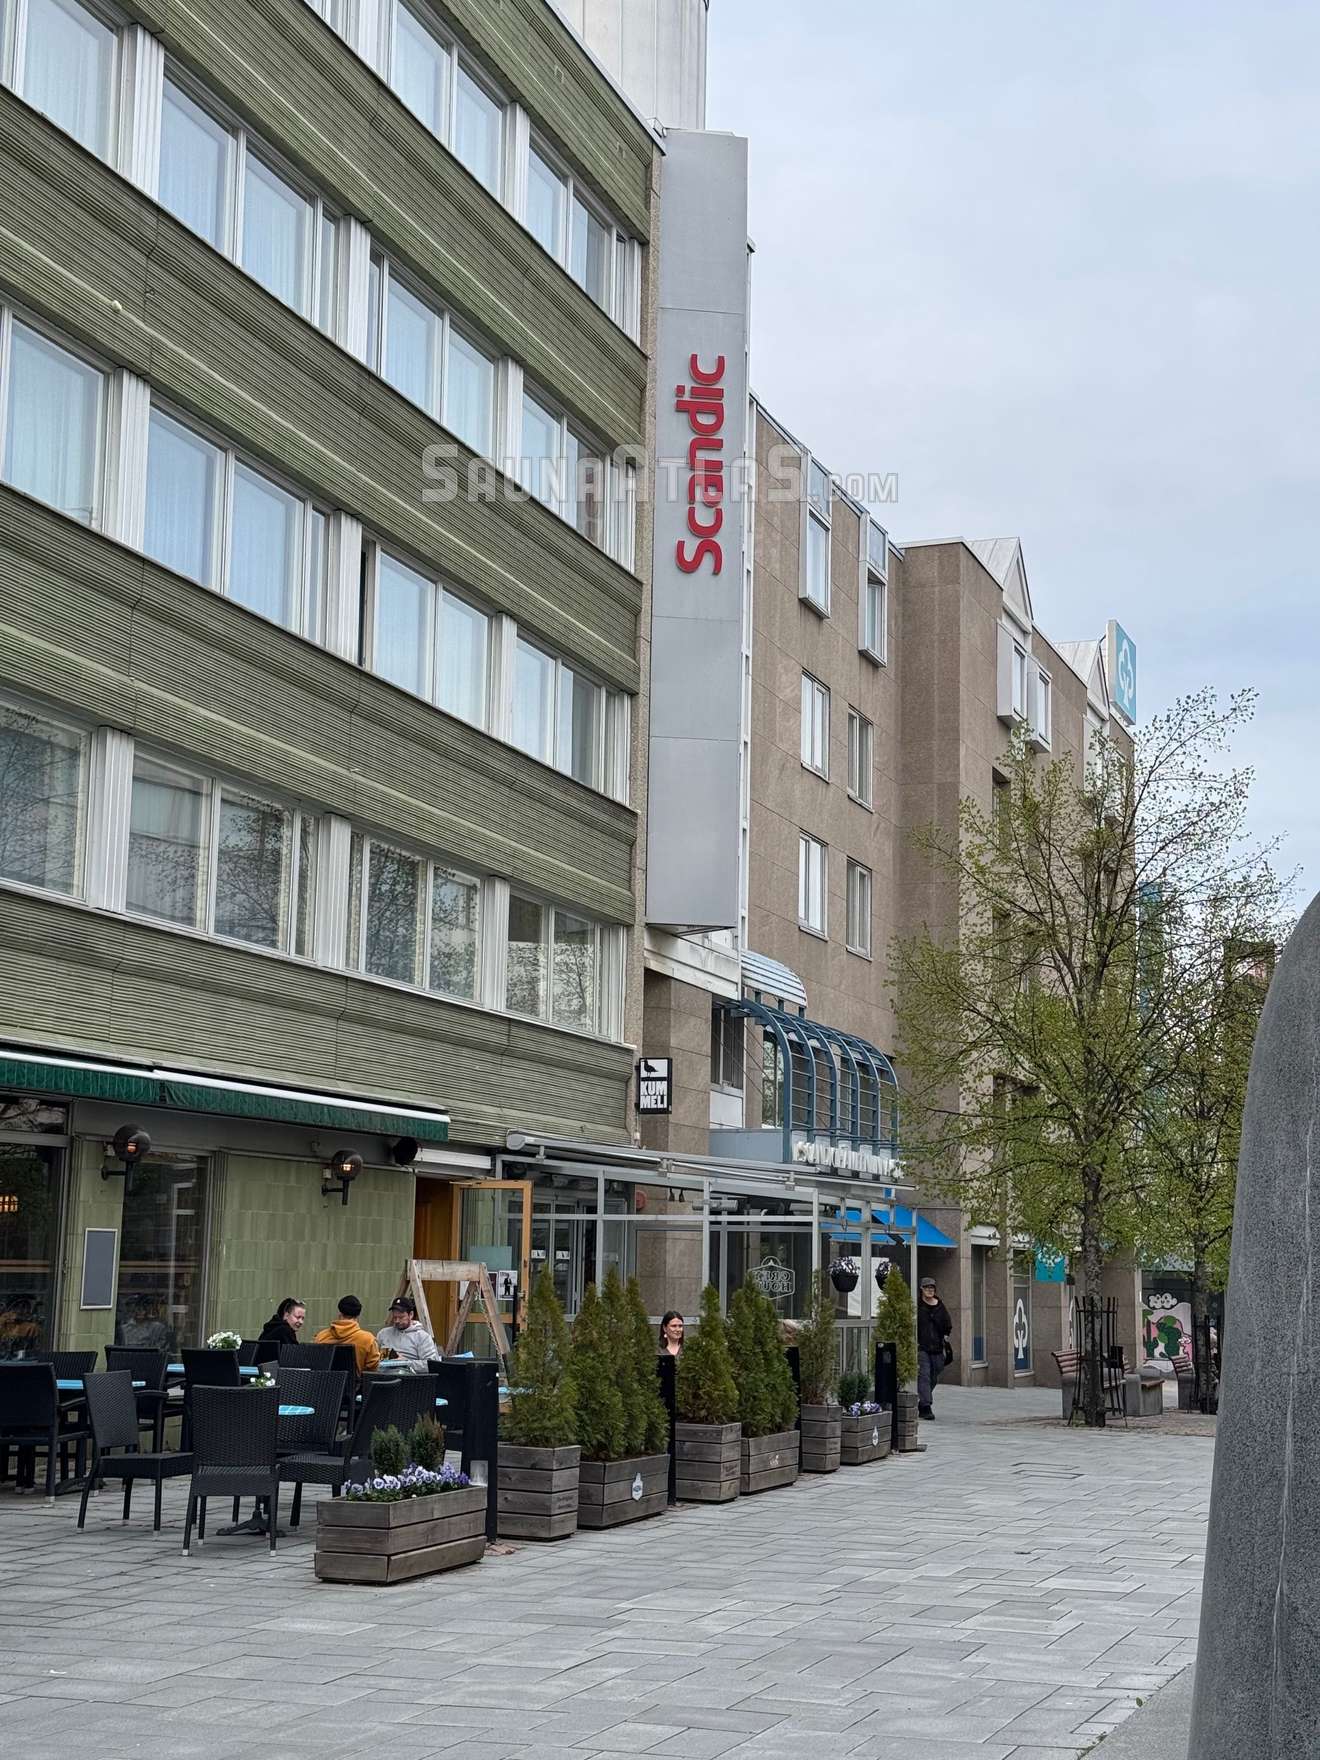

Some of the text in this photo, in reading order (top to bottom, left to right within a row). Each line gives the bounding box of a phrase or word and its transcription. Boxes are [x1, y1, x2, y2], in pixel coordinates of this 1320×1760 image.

[675, 353, 726, 576] Scandic
[640, 1081, 667, 1096] KUM
[640, 1095, 667, 1109] MELI
